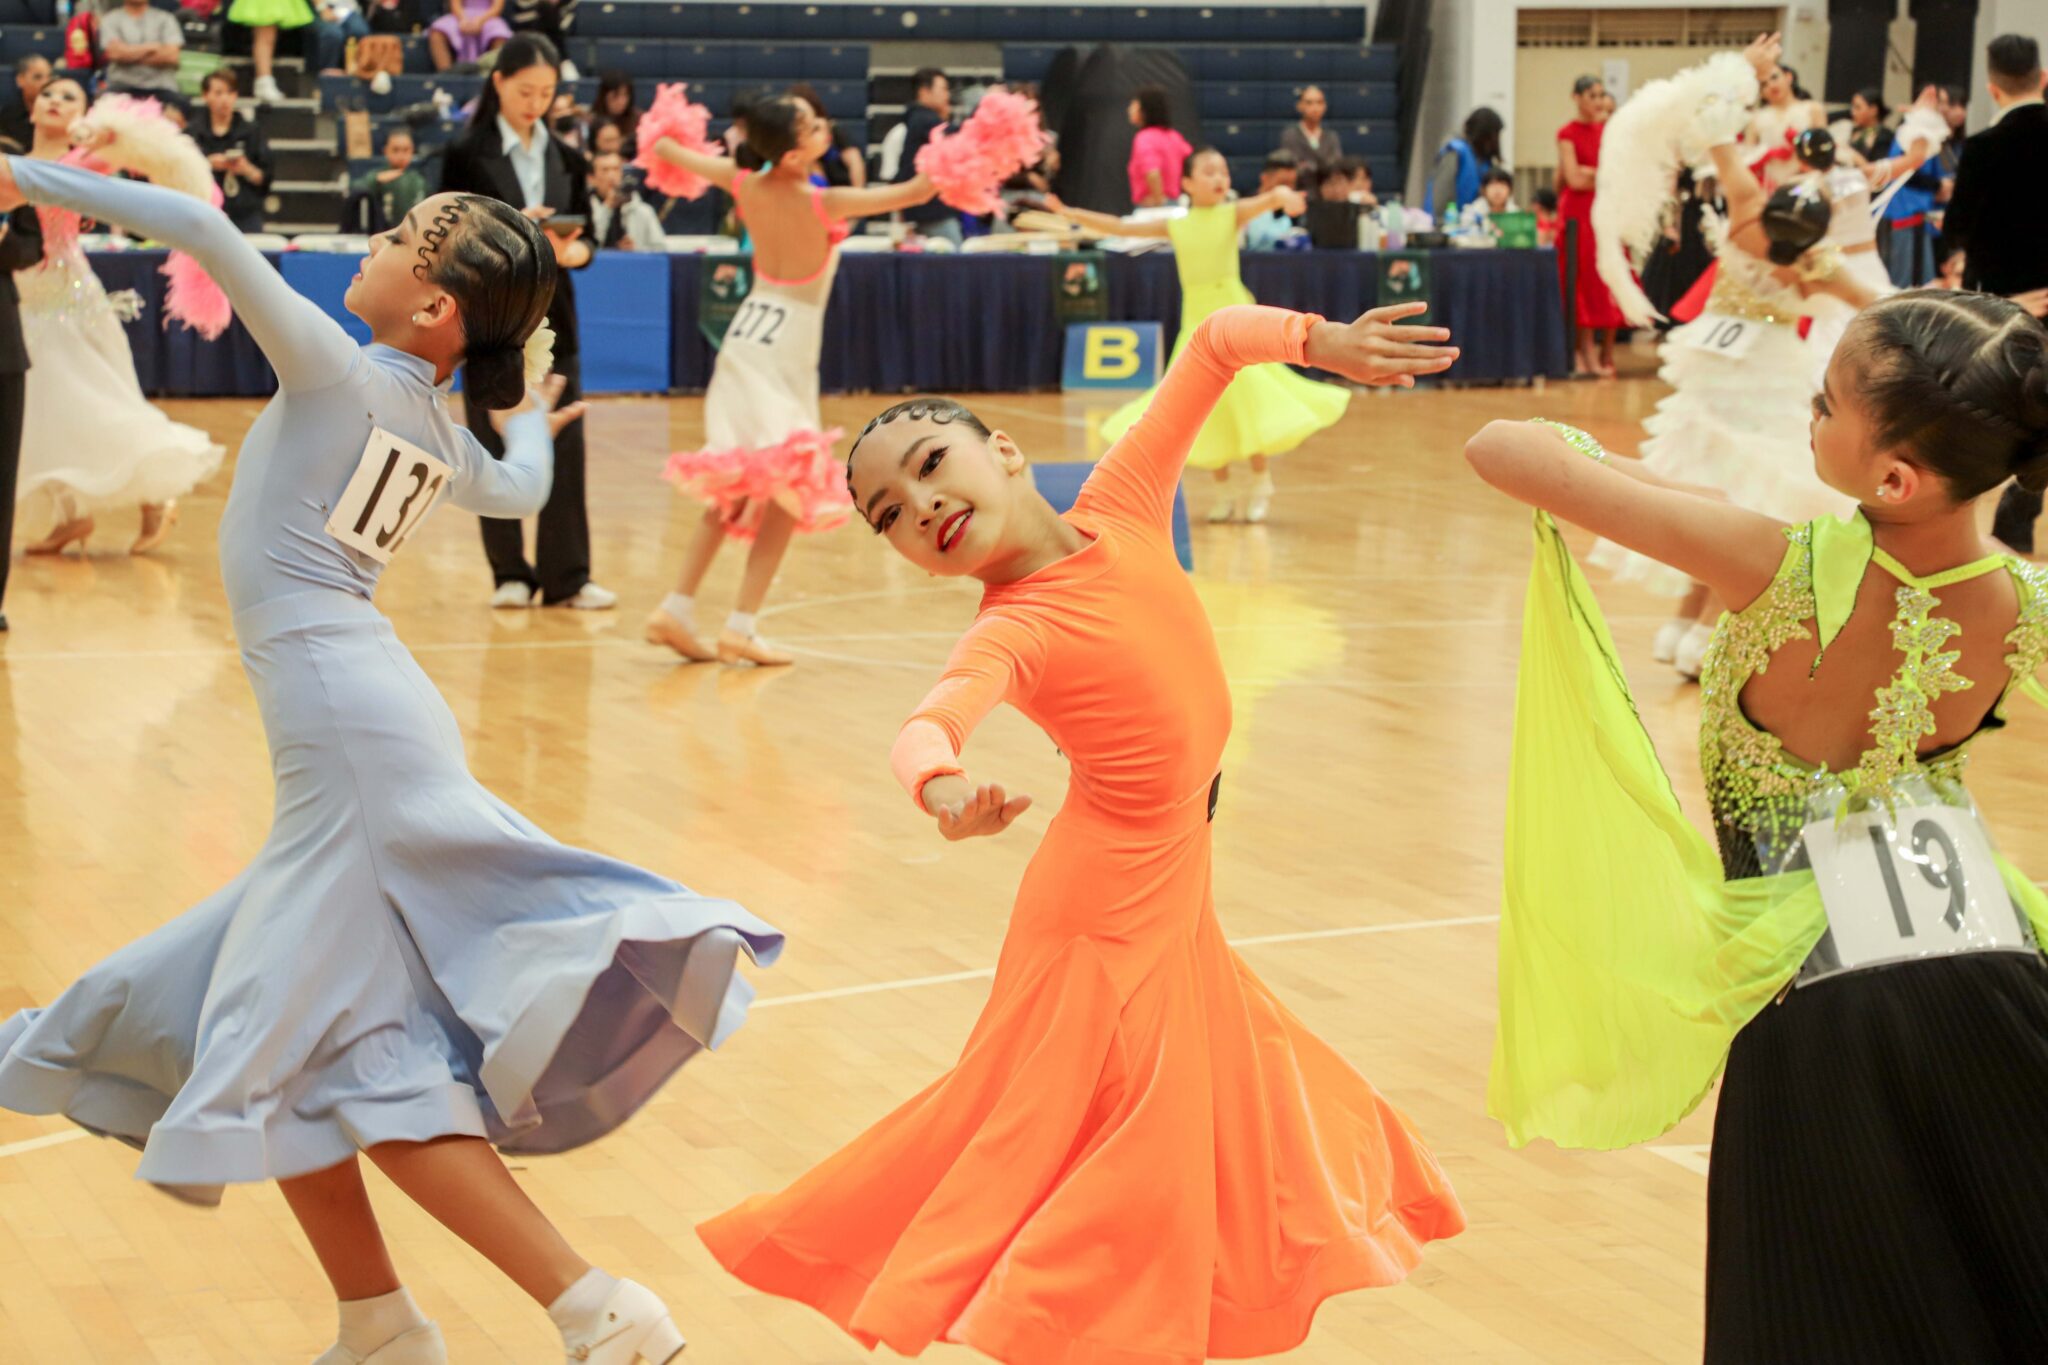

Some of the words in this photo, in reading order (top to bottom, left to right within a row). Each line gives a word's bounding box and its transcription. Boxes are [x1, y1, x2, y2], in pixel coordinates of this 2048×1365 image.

[733, 302, 786, 345] 272
[1702, 319, 1743, 348] 10
[1083, 326, 1141, 379] B
[1868, 818, 1966, 938] 19
